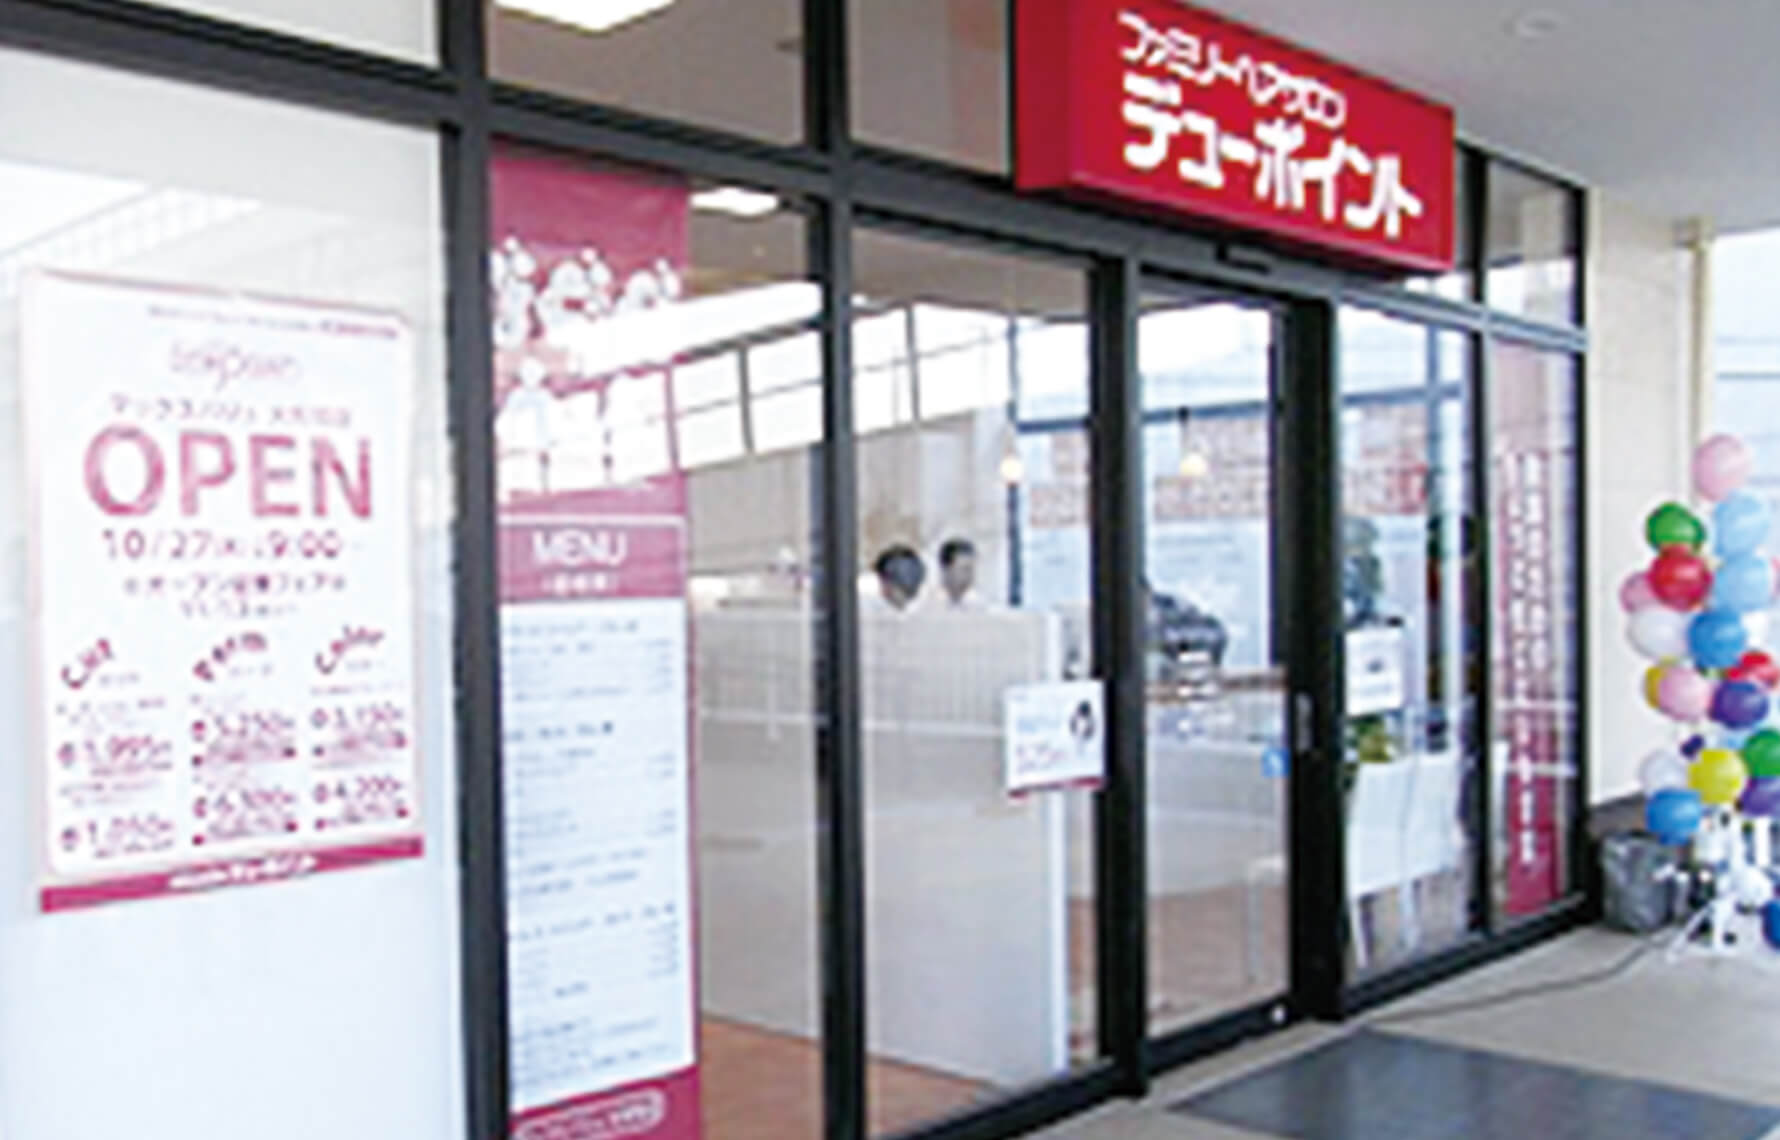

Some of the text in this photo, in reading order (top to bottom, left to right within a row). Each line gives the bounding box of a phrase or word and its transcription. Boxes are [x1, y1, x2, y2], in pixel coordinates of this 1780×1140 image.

[1122, 72, 1424, 239] デューポイント
[84, 423, 372, 519] OPEN
[532, 528, 628, 566] MENU
